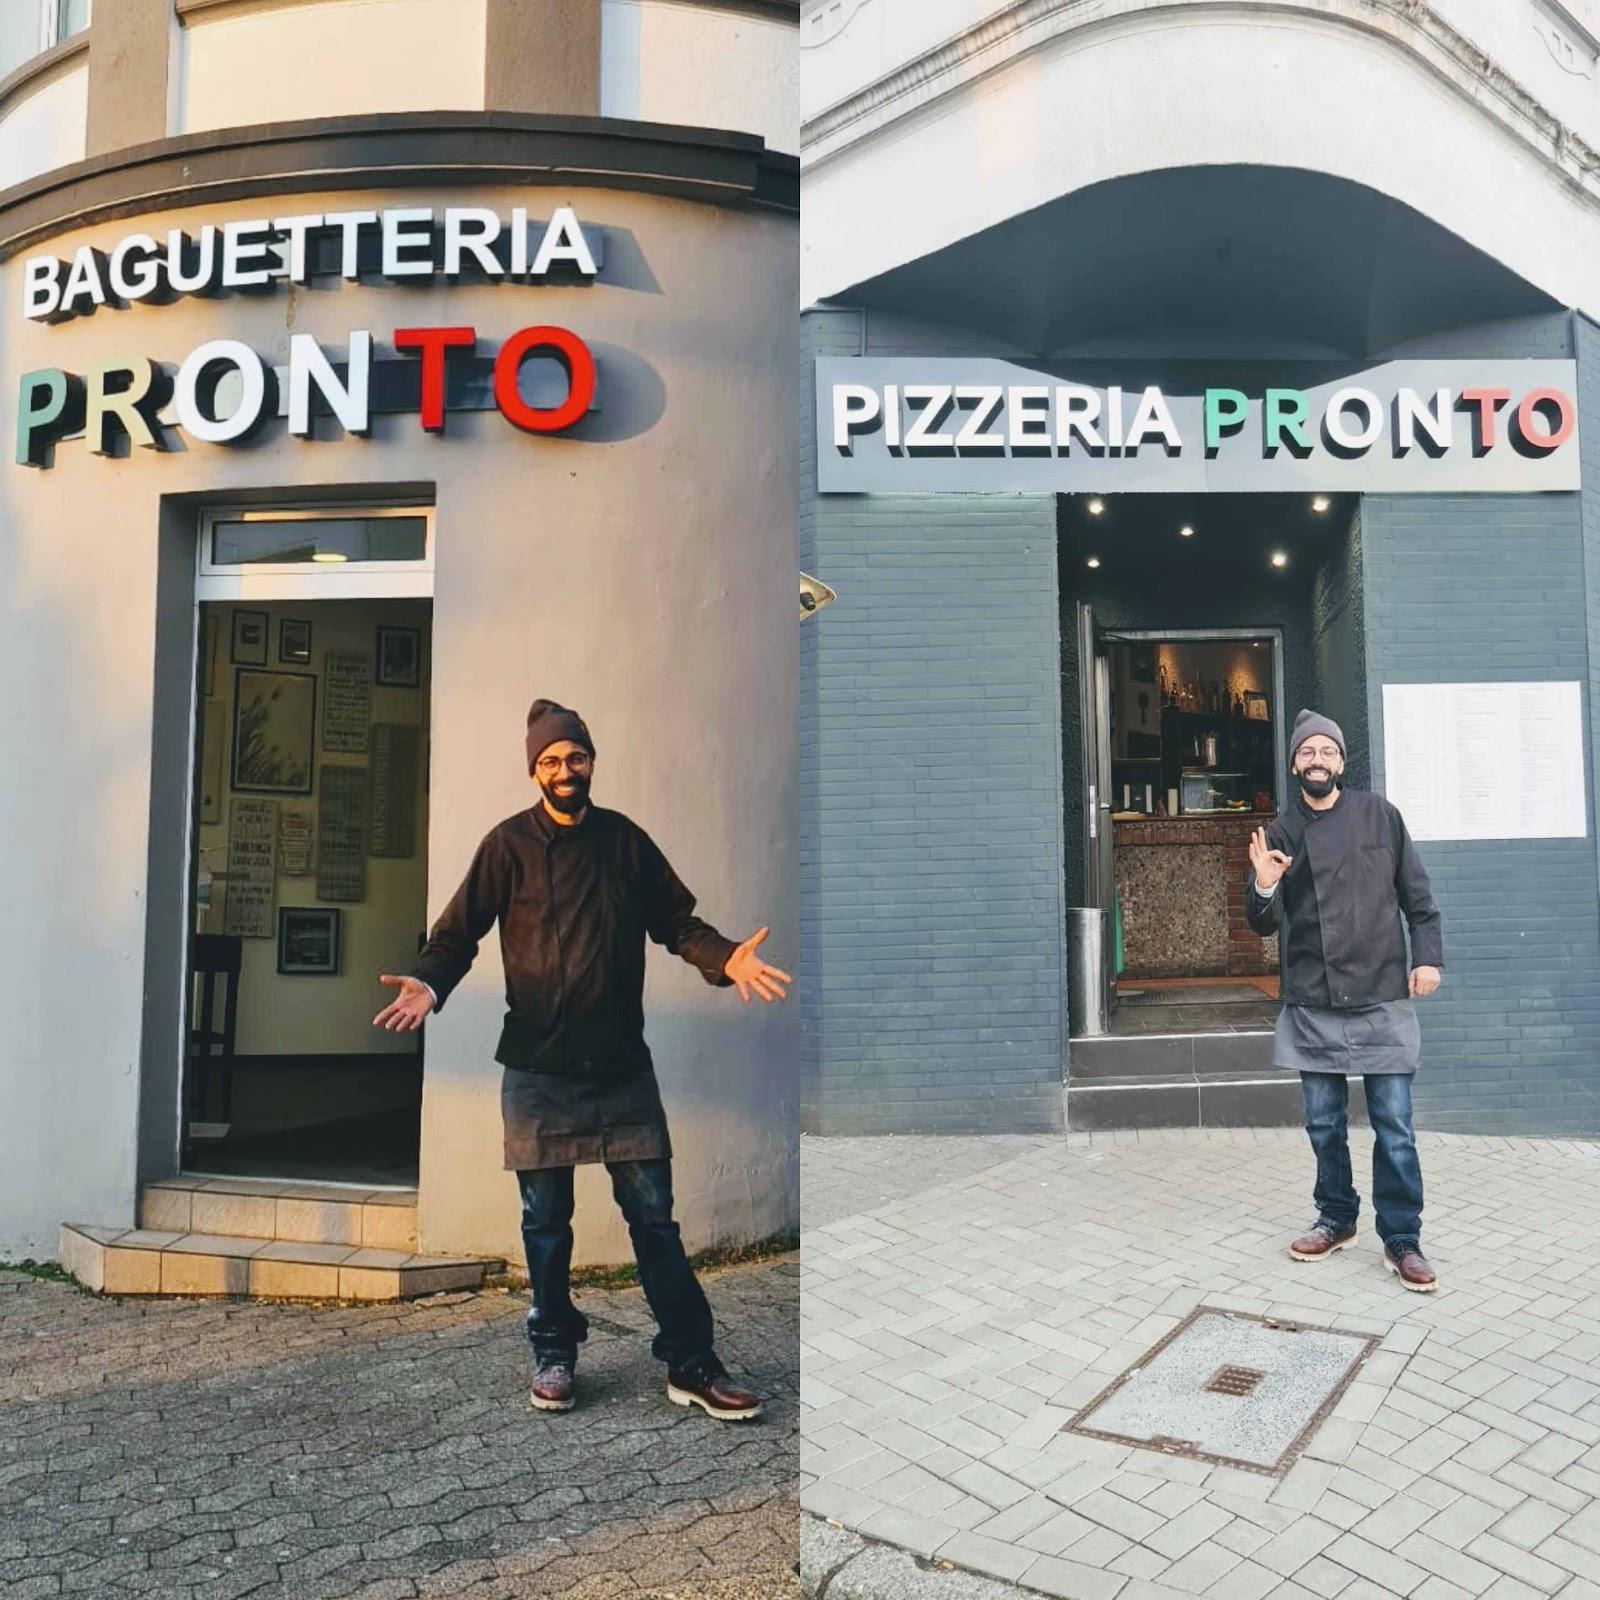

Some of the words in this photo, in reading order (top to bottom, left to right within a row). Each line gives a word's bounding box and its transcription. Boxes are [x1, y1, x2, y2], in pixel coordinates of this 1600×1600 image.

[24, 207, 598, 319] BAGUETTERIA
[16, 325, 597, 464] PRONTO
[832, 384, 1183, 453] PIZZERIA
[1204, 386, 1576, 453] PRONTO
